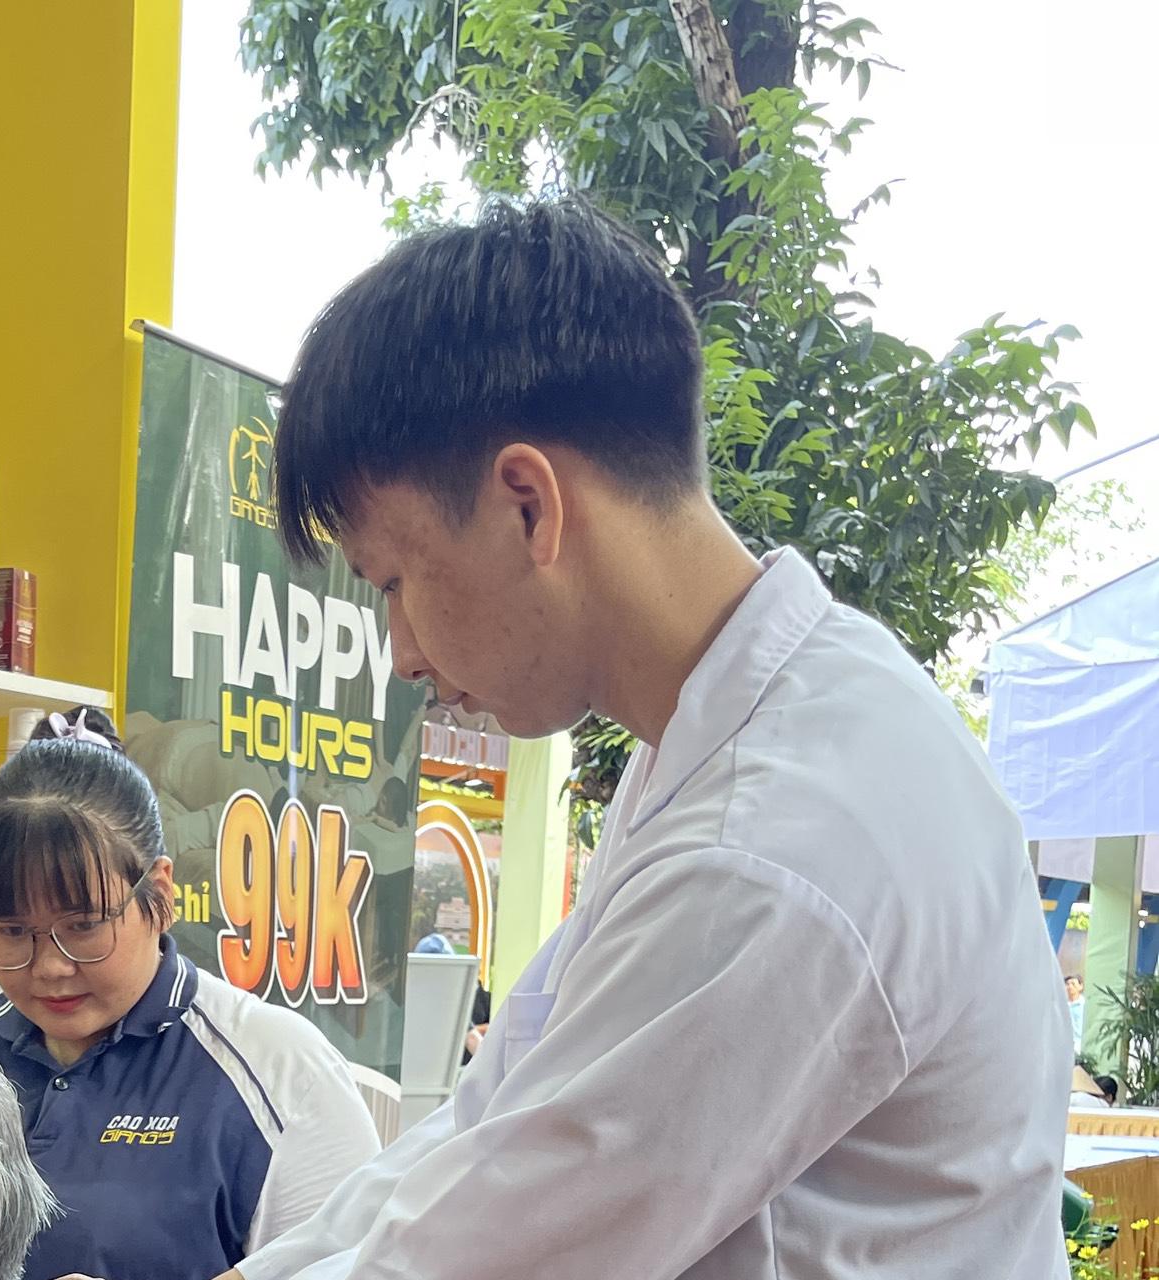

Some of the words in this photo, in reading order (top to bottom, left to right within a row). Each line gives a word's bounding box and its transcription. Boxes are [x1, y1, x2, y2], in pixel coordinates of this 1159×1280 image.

[172, 551, 393, 722] HAPPY
[221, 691, 373, 779] HOURS
[106, 1115, 143, 1130] CAO
[144, 1115, 179, 1131] XOA
